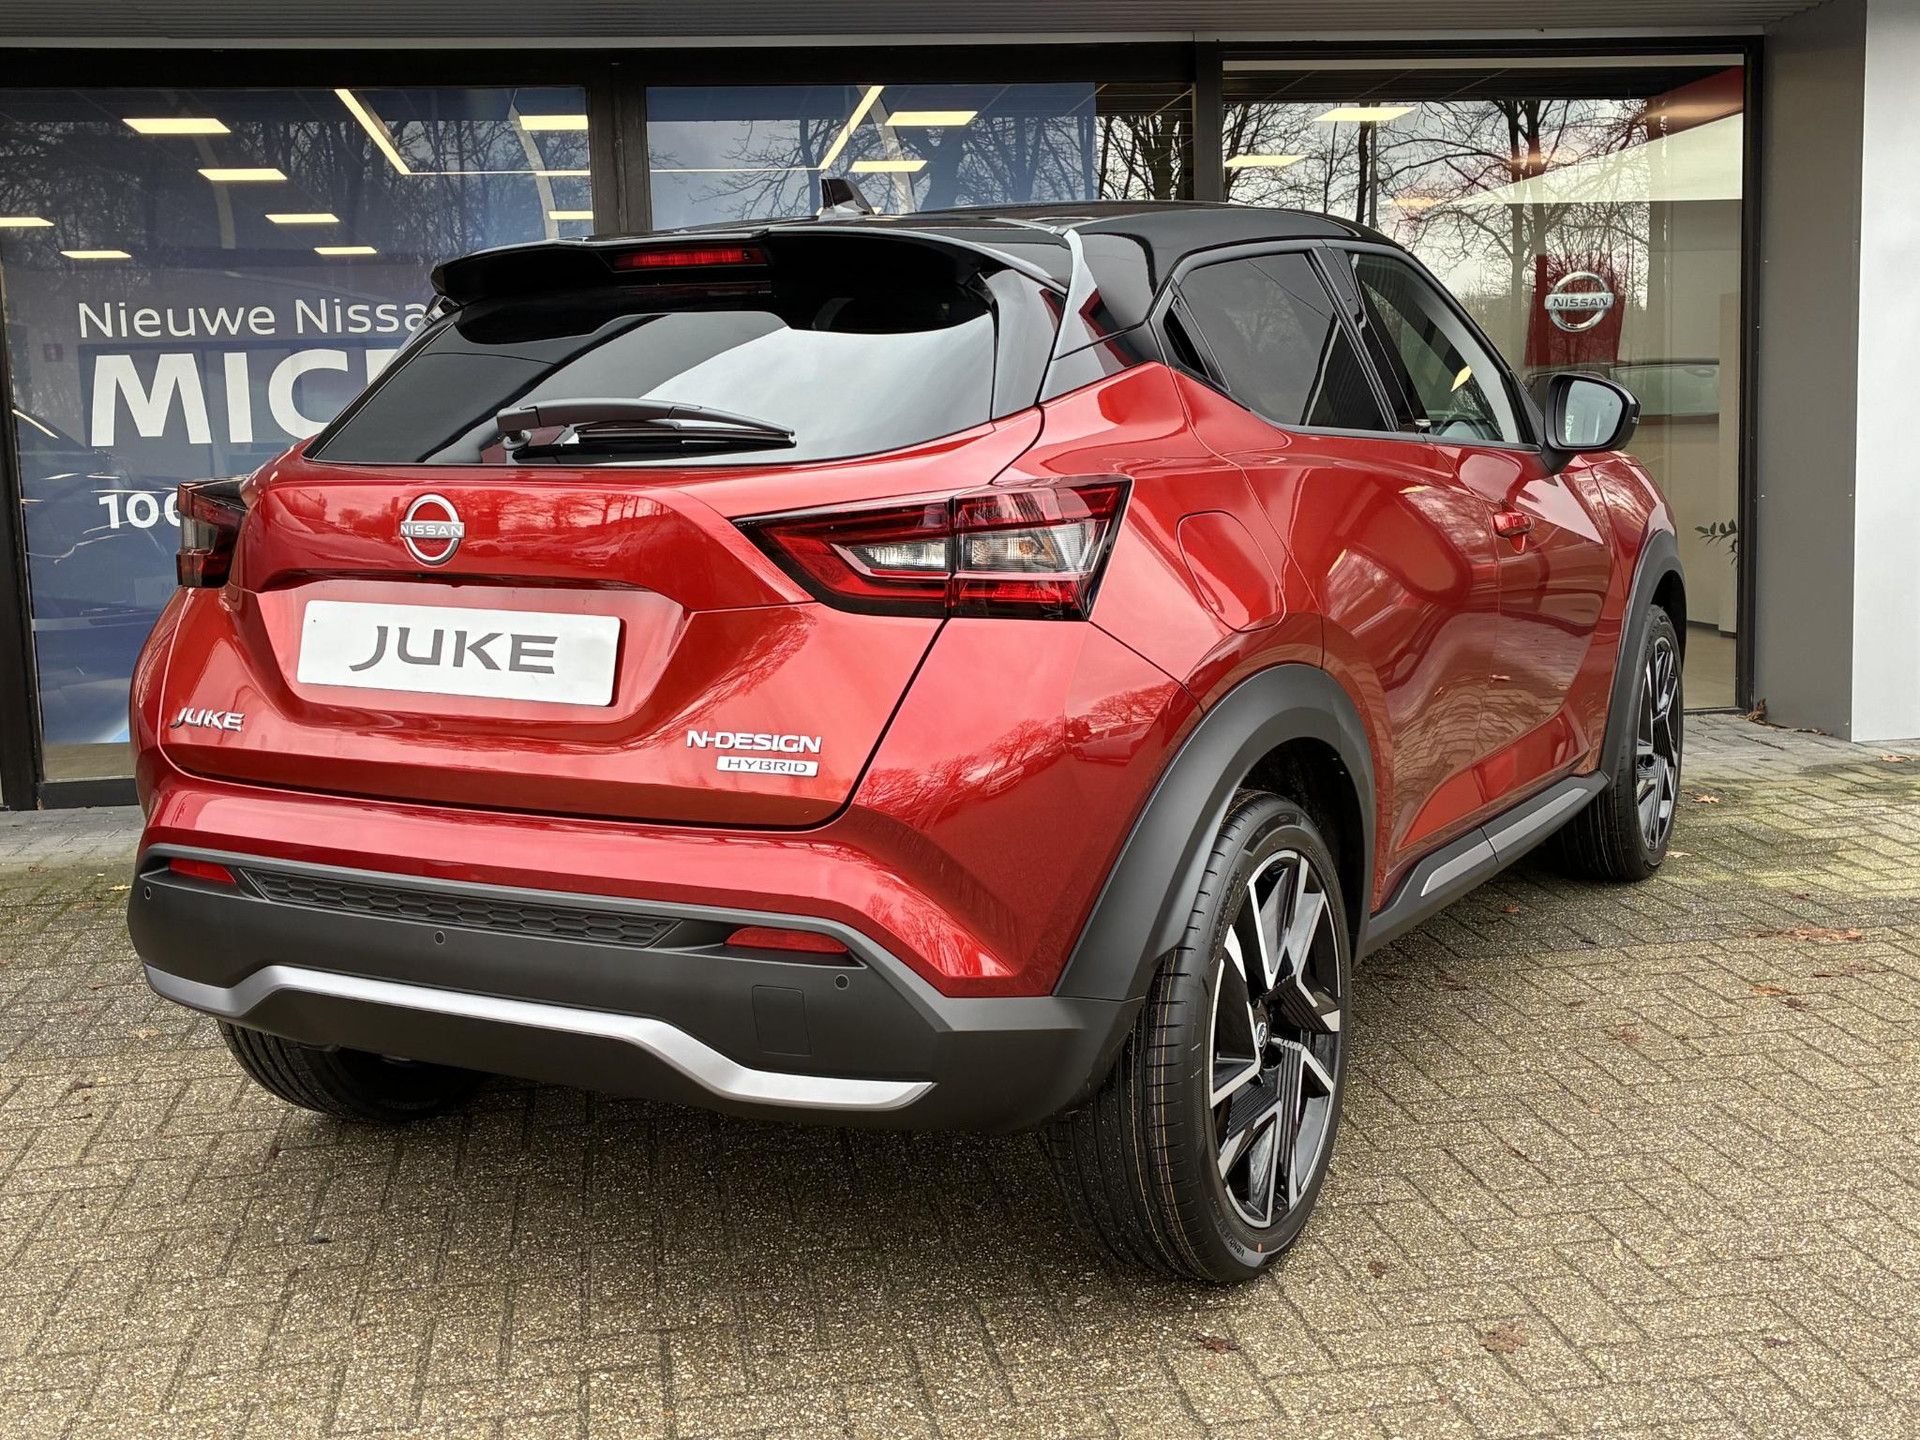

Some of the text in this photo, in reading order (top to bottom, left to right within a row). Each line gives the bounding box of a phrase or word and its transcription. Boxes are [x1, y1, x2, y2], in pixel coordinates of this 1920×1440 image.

[1552, 297, 1609, 308] NISSAN
[78, 301, 276, 339] Nieuwe
[90, 347, 398, 447] MIC
[400, 524, 463, 536] NISSAN
[348, 625, 559, 675] JUKE
[169, 706, 246, 732] JUKE
[686, 729, 822, 754] N-DESIGN
[727, 758, 808, 773] HYBRID
